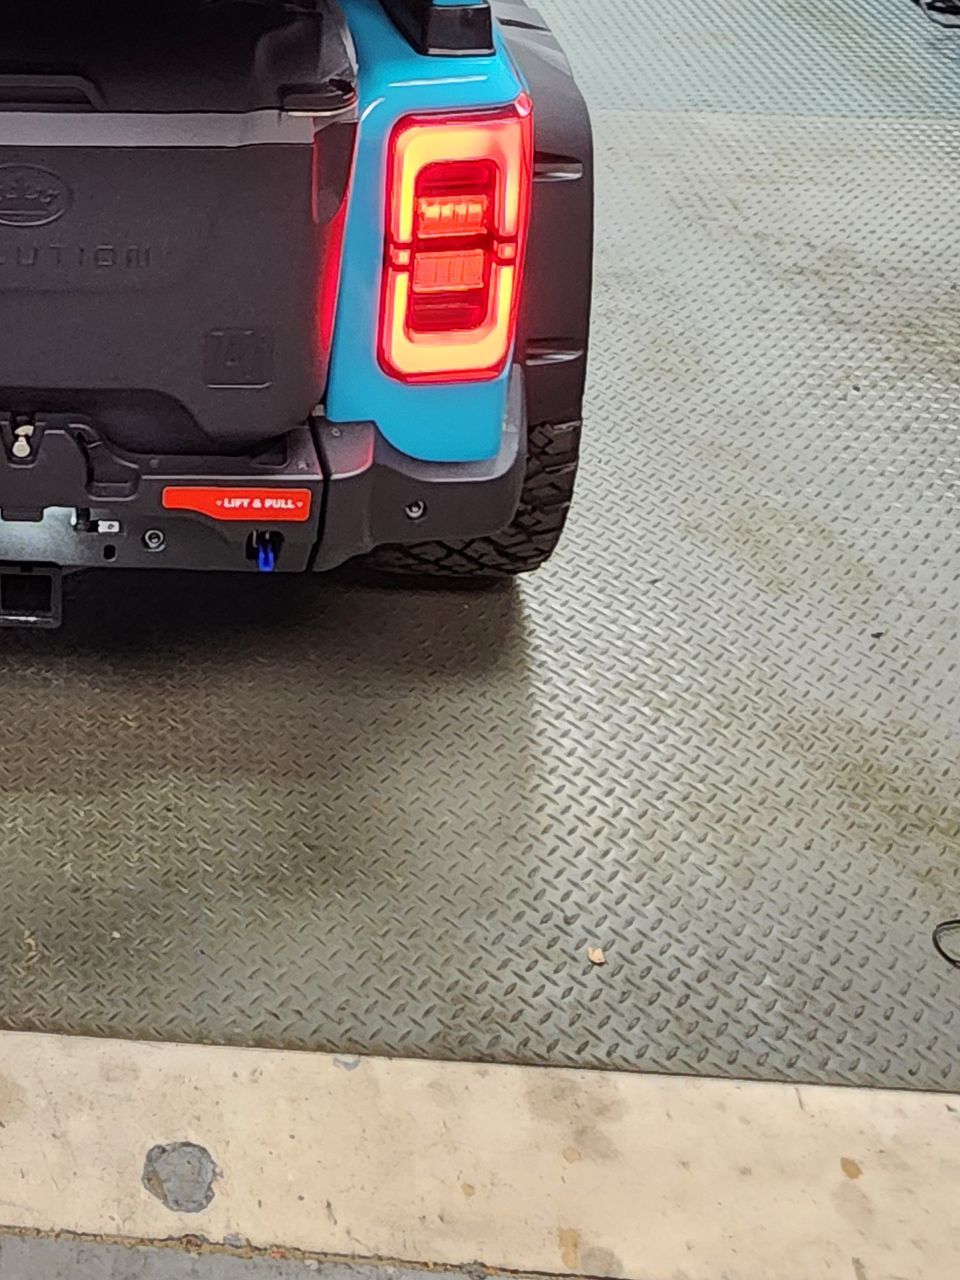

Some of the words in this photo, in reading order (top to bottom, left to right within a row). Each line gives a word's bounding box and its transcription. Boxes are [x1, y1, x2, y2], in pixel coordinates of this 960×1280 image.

[223, 497, 251, 508] LIFT
[252, 498, 262, 508] &
[264, 498, 296, 509] PULL
